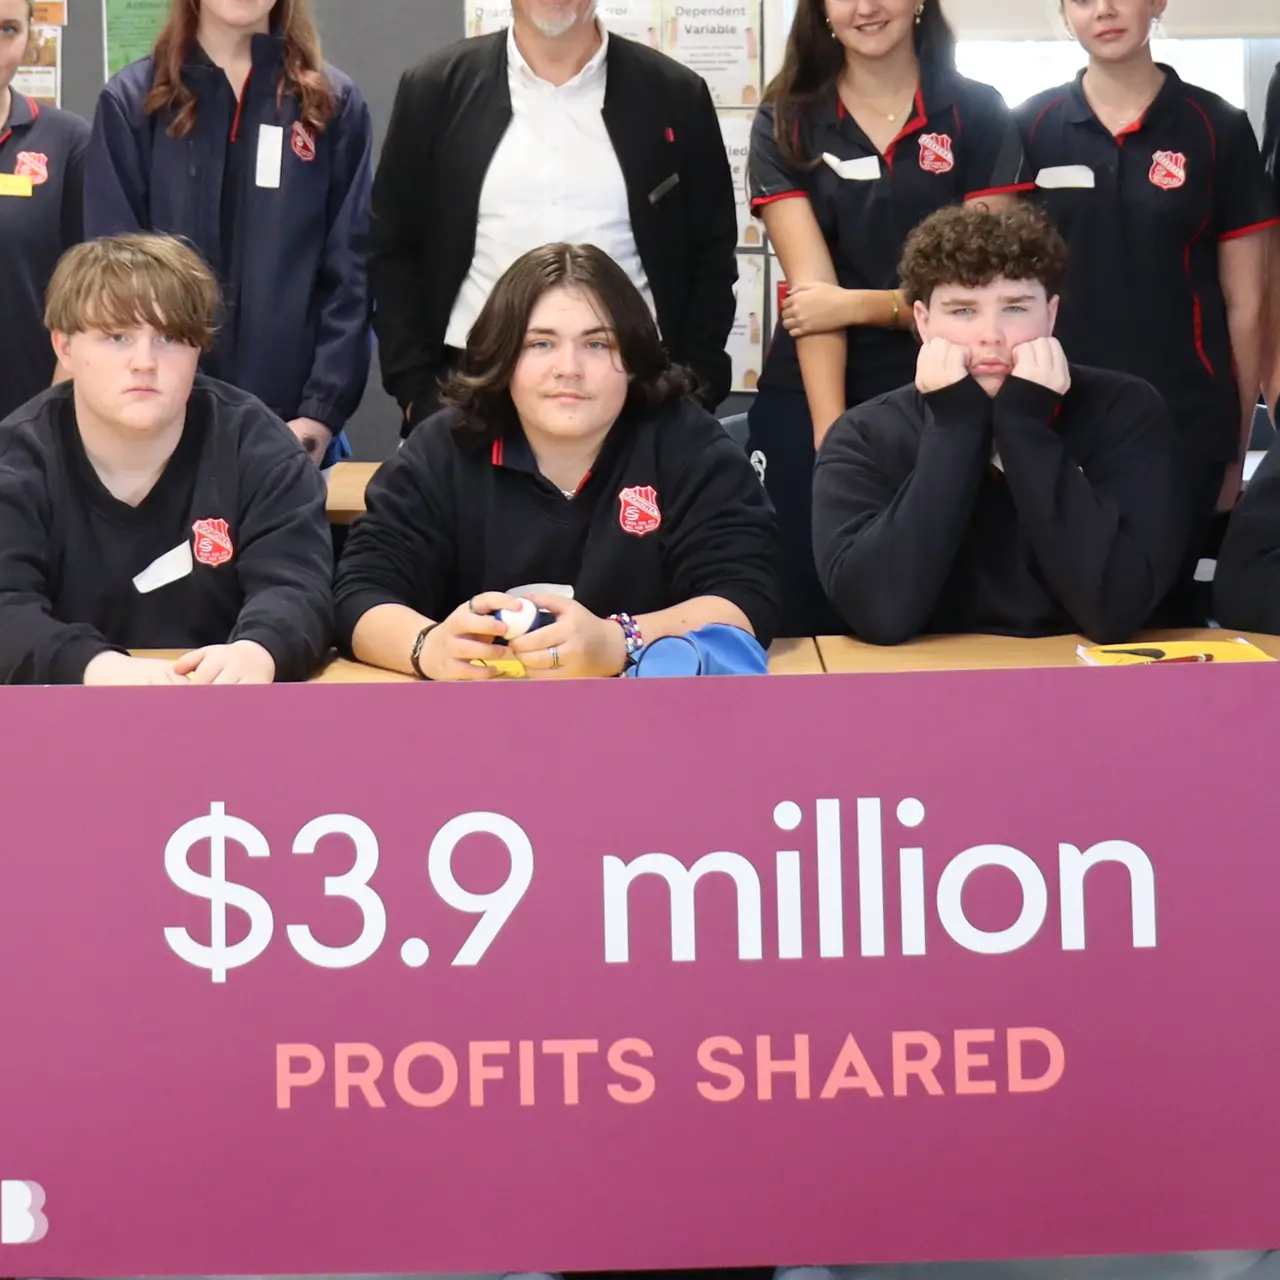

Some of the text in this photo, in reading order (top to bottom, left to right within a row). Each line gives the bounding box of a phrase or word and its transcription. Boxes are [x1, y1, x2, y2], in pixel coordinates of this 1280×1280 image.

[674, 5, 747, 19] Dependent
[684, 23, 738, 36] Variable
[164, 798, 1156, 982] $3.9 million
[277, 1028, 1064, 1108] PROFITS SHARED
